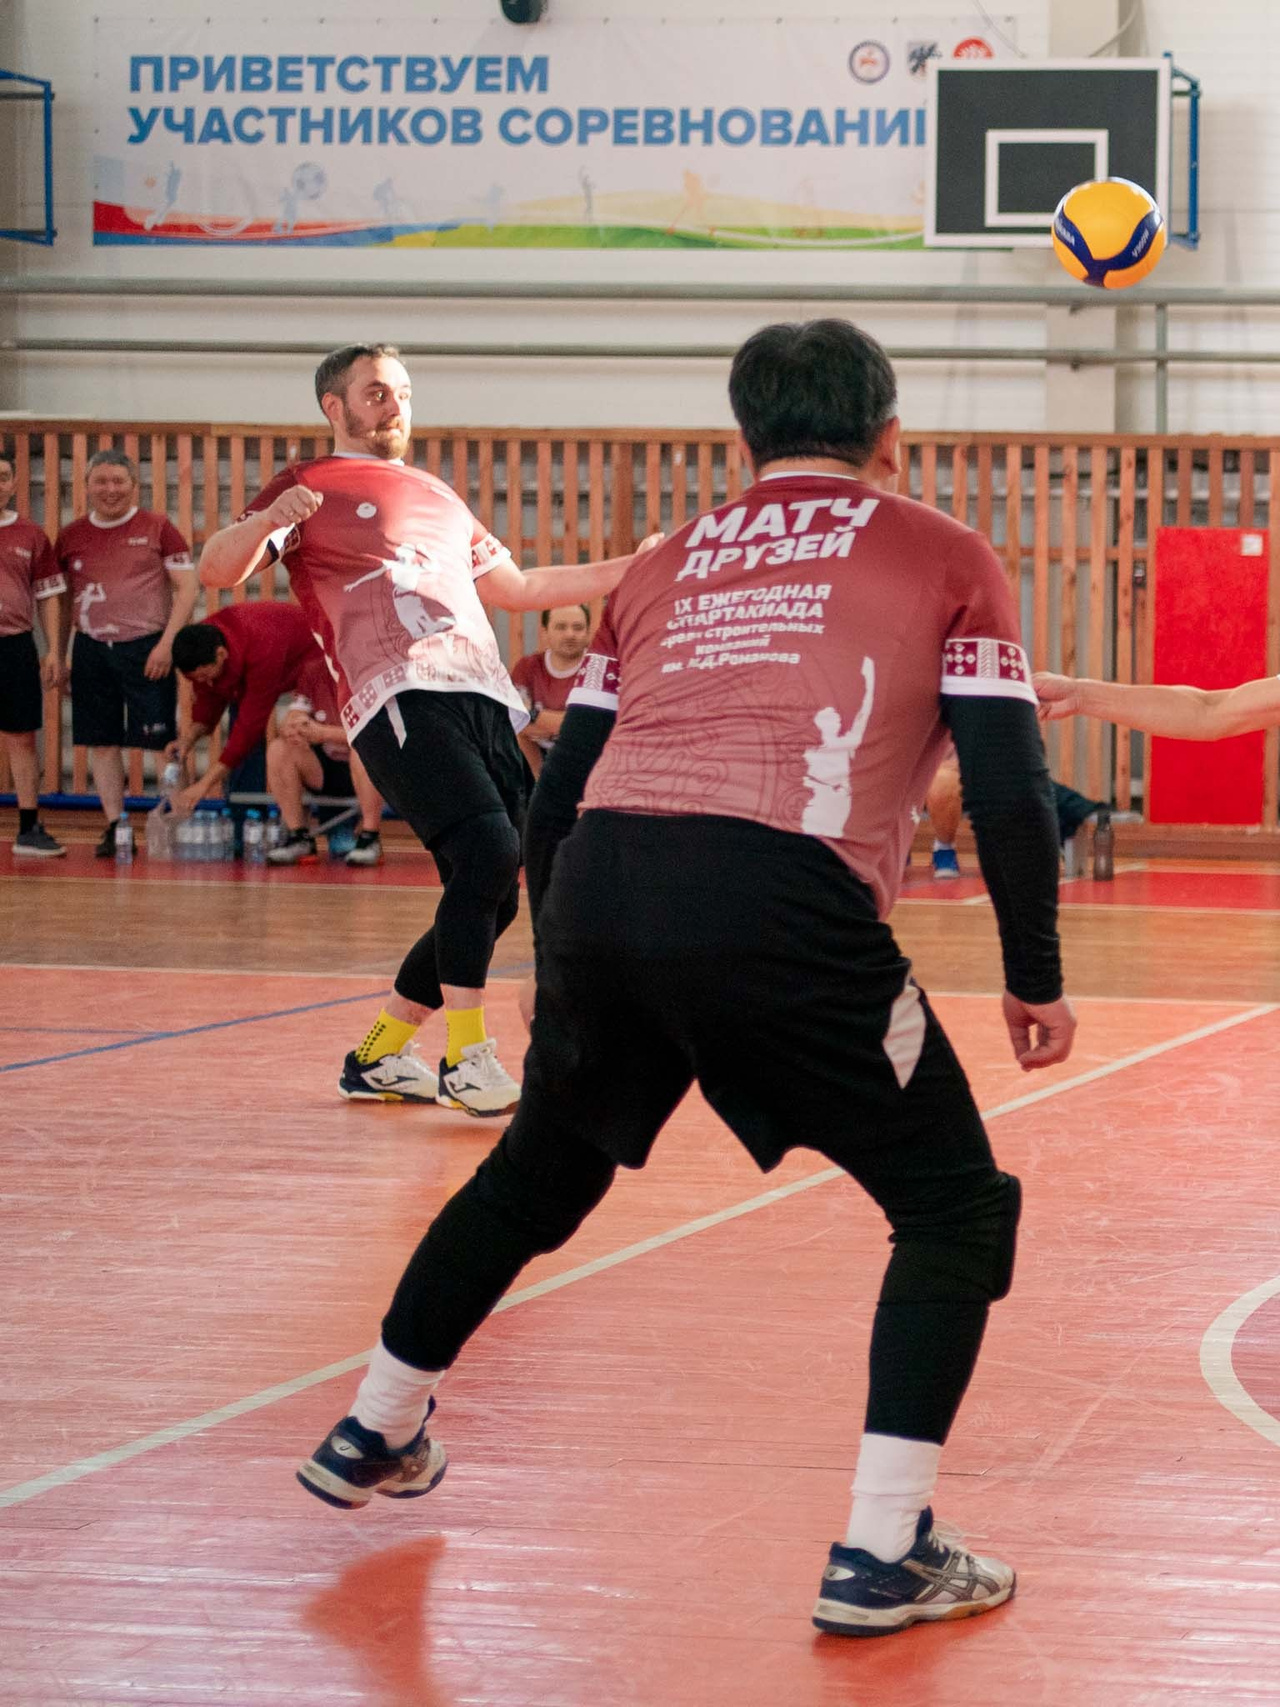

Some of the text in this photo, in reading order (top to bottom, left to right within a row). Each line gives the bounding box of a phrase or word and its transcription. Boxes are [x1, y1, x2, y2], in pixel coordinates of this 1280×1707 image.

[129, 55, 550, 93] ПРИВЕТСТВУЕМ
[127, 107, 484, 145] УЧАСТНИКОВ
[685, 498, 880, 547] МАТЧ
[674, 526, 856, 581] ДРУЗЕЙ
[666, 602, 824, 630] СПАРТАКИАДА
[674, 584, 832, 615] IX ЕЖЕГОДНАЯ
